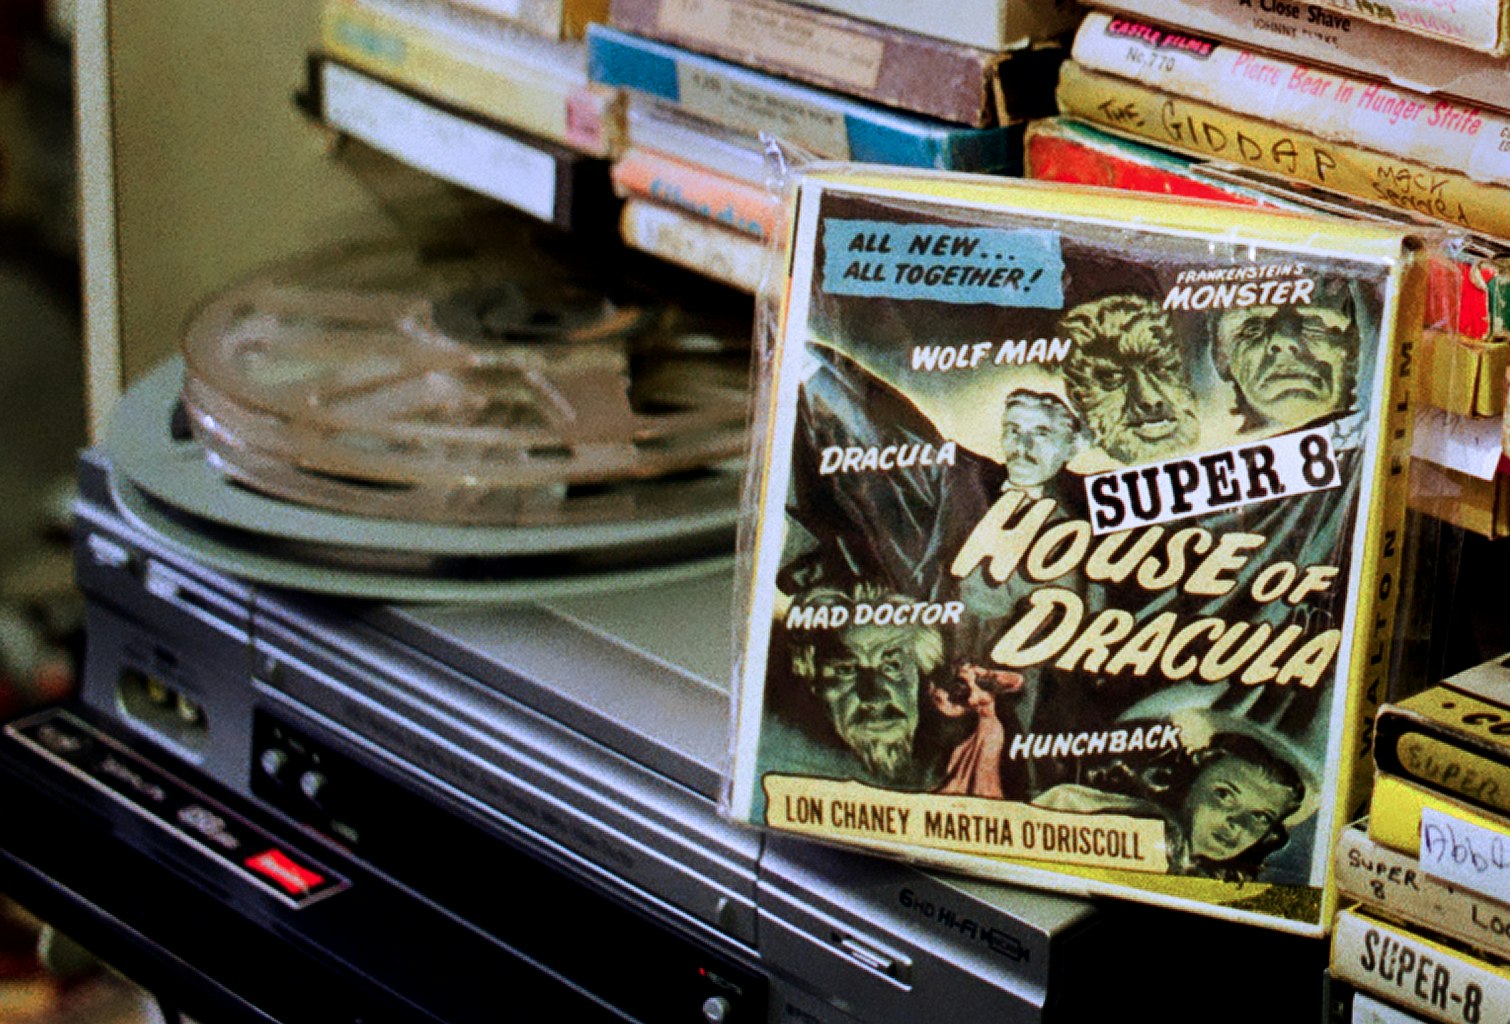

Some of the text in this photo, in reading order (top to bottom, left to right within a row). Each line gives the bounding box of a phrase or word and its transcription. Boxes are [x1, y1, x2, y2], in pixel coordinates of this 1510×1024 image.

[1108, 18, 1213, 56] CASTLE FILMS
[1307, 4, 1351, 33] Shave
[1231, 50, 1280, 88] Pierre
[1287, 64, 1333, 99] Bear
[1357, 83, 1427, 128] Hunger
[1427, 100, 1484, 137] Strife
[1161, 100, 1338, 182] GIDDAP
[847, 232, 893, 254] ALL
[842, 261, 1043, 293] ALL TOGETHER!
[1176, 262, 1307, 285] FRANKENSTEIN'S
[1162, 280, 1316, 312] MONSTER
[911, 336, 1075, 373] WOLF MAN
[818, 441, 957, 476] DRACULA
[1090, 433, 1336, 530] SUPER 8
[950, 490, 1341, 606] HOUSE OF
[1358, 528, 1398, 760] WALTON
[1390, 339, 1414, 477] FILM
[787, 599, 966, 630] MAD DOCTOR
[989, 585, 1343, 689] DRACULA
[1009, 723, 1184, 760] HUNCHBACK
[784, 793, 1146, 862] LON CHANEY MARTHA O'DRISCOLL
[937, 906, 980, 940] HI-FI
[1359, 928, 1484, 1024] SUPER-8
